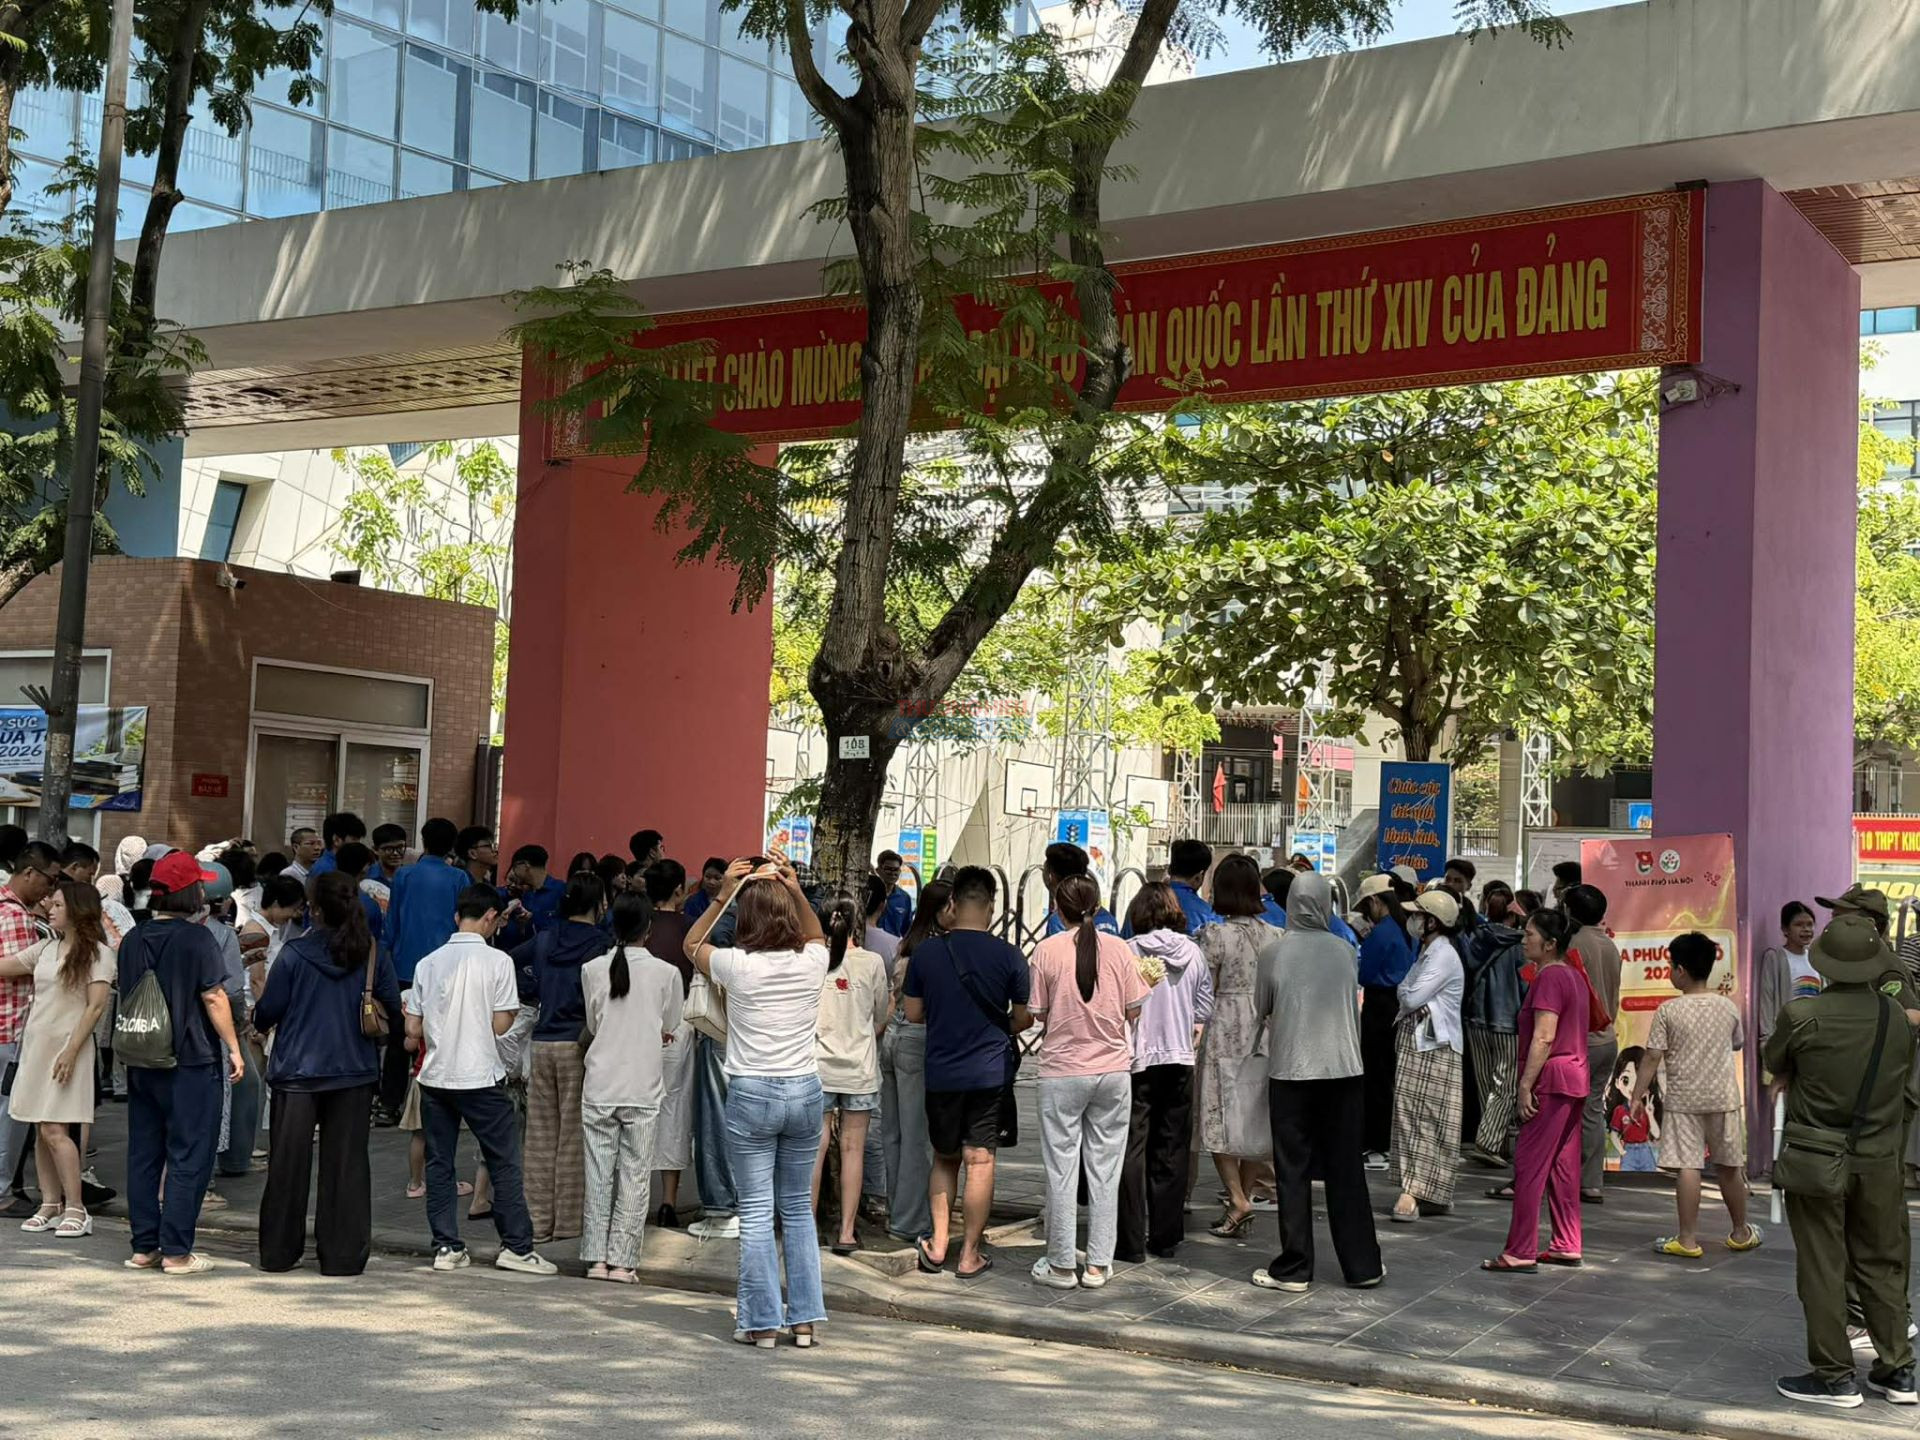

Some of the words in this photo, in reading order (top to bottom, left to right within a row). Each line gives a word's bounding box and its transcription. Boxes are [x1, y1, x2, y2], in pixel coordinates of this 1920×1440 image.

[723, 338, 784, 412] CHÀO
[790, 330, 862, 406] MỪNG
[1166, 279, 1241, 380] QUỐC
[1251, 272, 1307, 364] LẦN
[1316, 266, 1377, 357] THỨ
[1382, 278, 1433, 351] XIV
[1442, 243, 1505, 344] CỦA
[1516, 232, 1608, 337] ĐẢNG
[7, 715, 38, 729] SỨC
[0, 728, 25, 745] ÙA
[0, 744, 42, 757] 2026
[1875, 831, 1900, 851] THPT
[1644, 966, 1672, 980] 202
